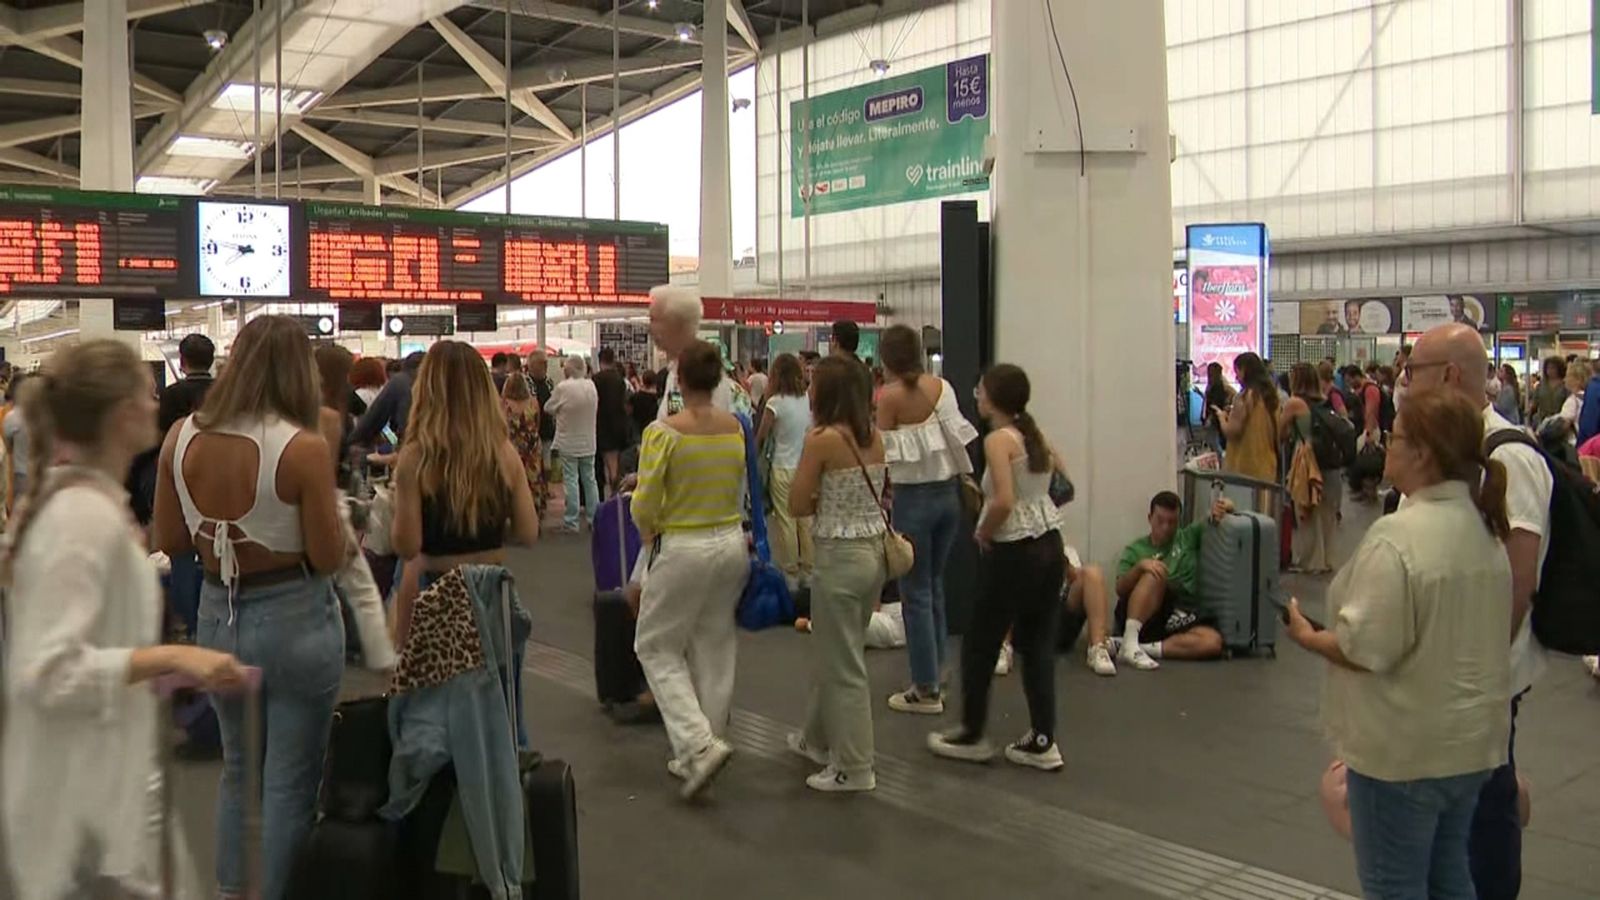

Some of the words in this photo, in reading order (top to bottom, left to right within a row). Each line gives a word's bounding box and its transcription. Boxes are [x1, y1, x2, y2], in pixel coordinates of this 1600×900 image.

[955, 64, 979, 78] Hasta
[953, 76, 982, 98] 15€
[953, 96, 981, 110] menos
[797, 119, 815, 132] Ua
[816, 114, 824, 127] el
[826, 108, 861, 126] código
[869, 93, 919, 117] MEPIRO
[836, 133, 866, 148] llevar.
[868, 118, 940, 142] Literalmente.
[237, 211, 253, 224] 12
[206, 243, 218, 255] 9
[272, 245, 282, 256] 3
[240, 276, 251, 288] 6
